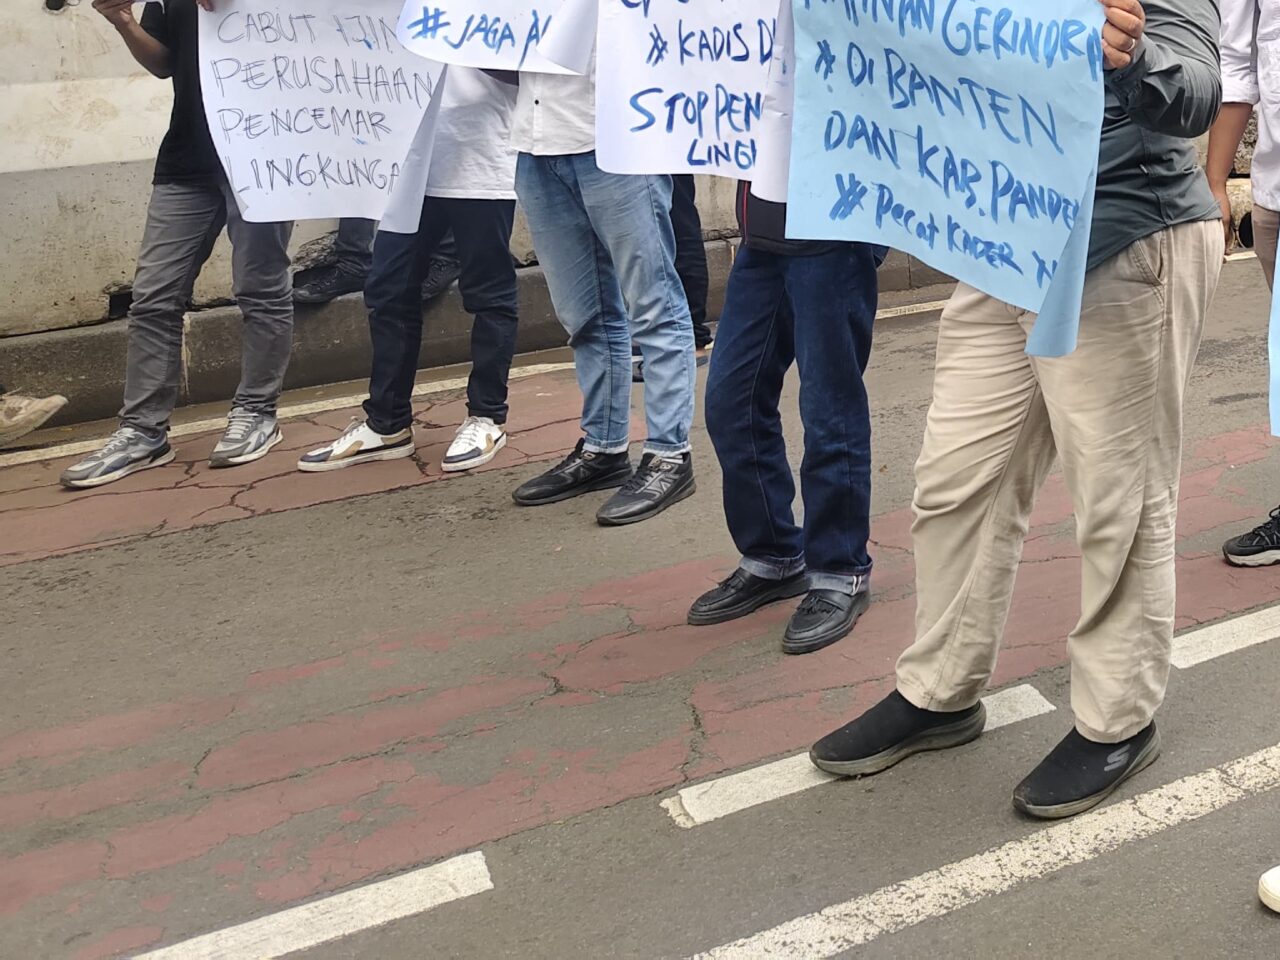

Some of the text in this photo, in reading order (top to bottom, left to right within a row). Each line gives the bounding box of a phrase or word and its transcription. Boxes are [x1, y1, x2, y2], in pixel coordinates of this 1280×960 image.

[217, 10, 316, 45] CABUT
[211, 55, 433, 110] PERUSAHAAN
[884, 47, 1064, 155] BANTEN
[216, 106, 392, 143] PENCEMAR
[824, 110, 899, 170] DAN
